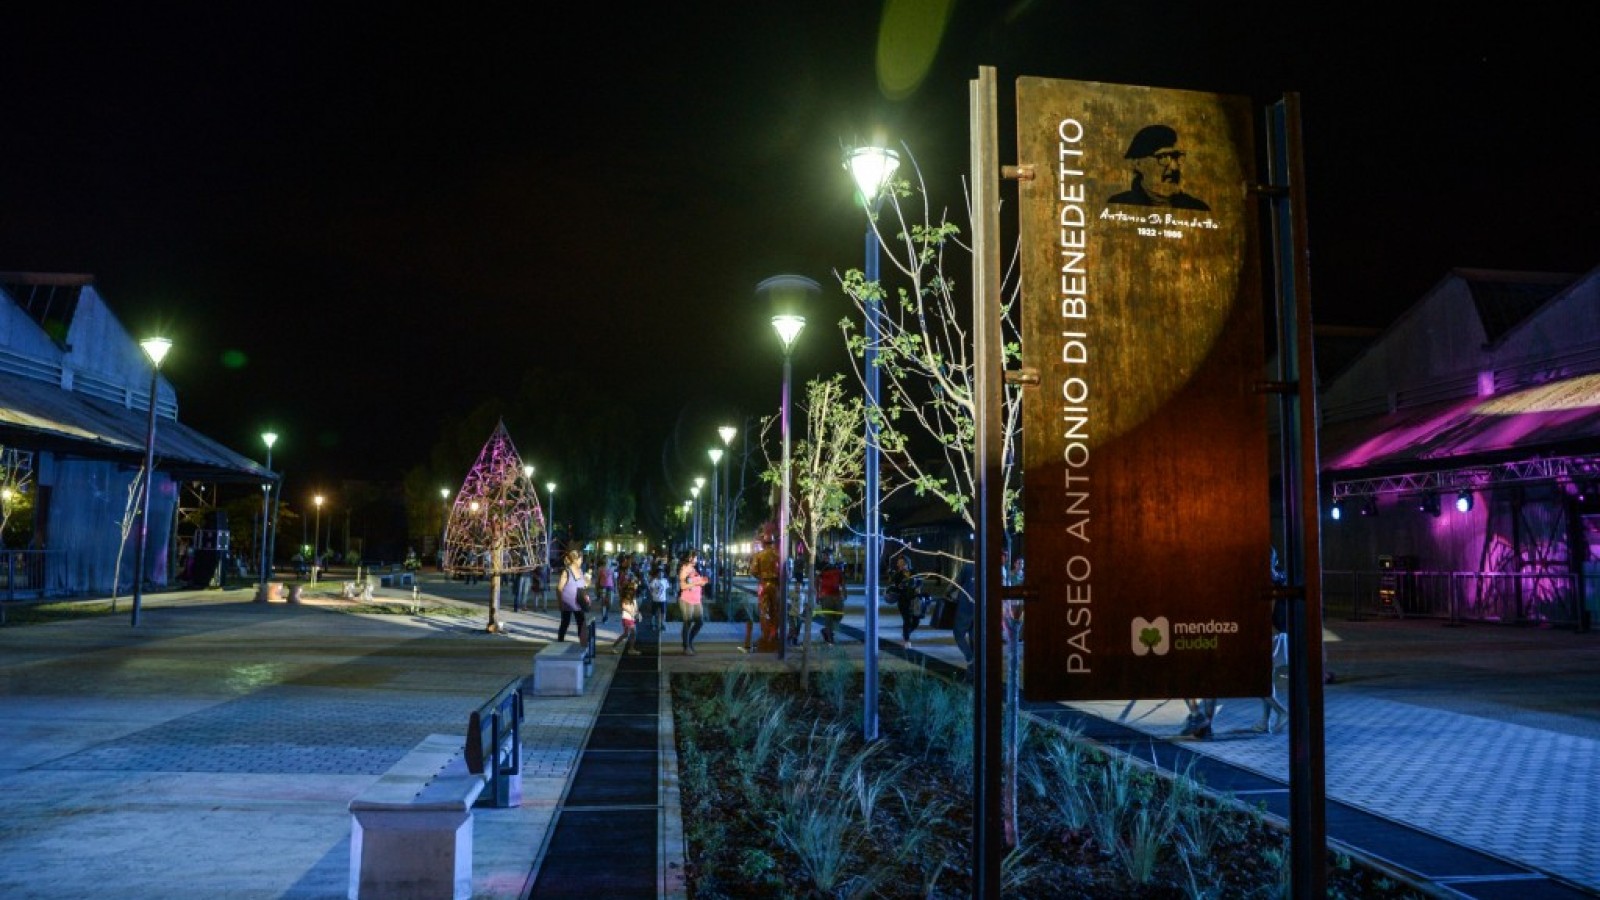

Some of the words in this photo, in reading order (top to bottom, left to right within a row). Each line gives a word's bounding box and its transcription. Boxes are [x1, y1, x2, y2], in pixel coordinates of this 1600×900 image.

[1058, 118, 1087, 319] BENEDETTO
[1062, 332, 1088, 364] DI
[1063, 377, 1090, 543] ANTONIO
[1066, 555, 1092, 674] PASEO
[1174, 619, 1239, 634] mendoza
[1174, 636, 1217, 649] ciudad
